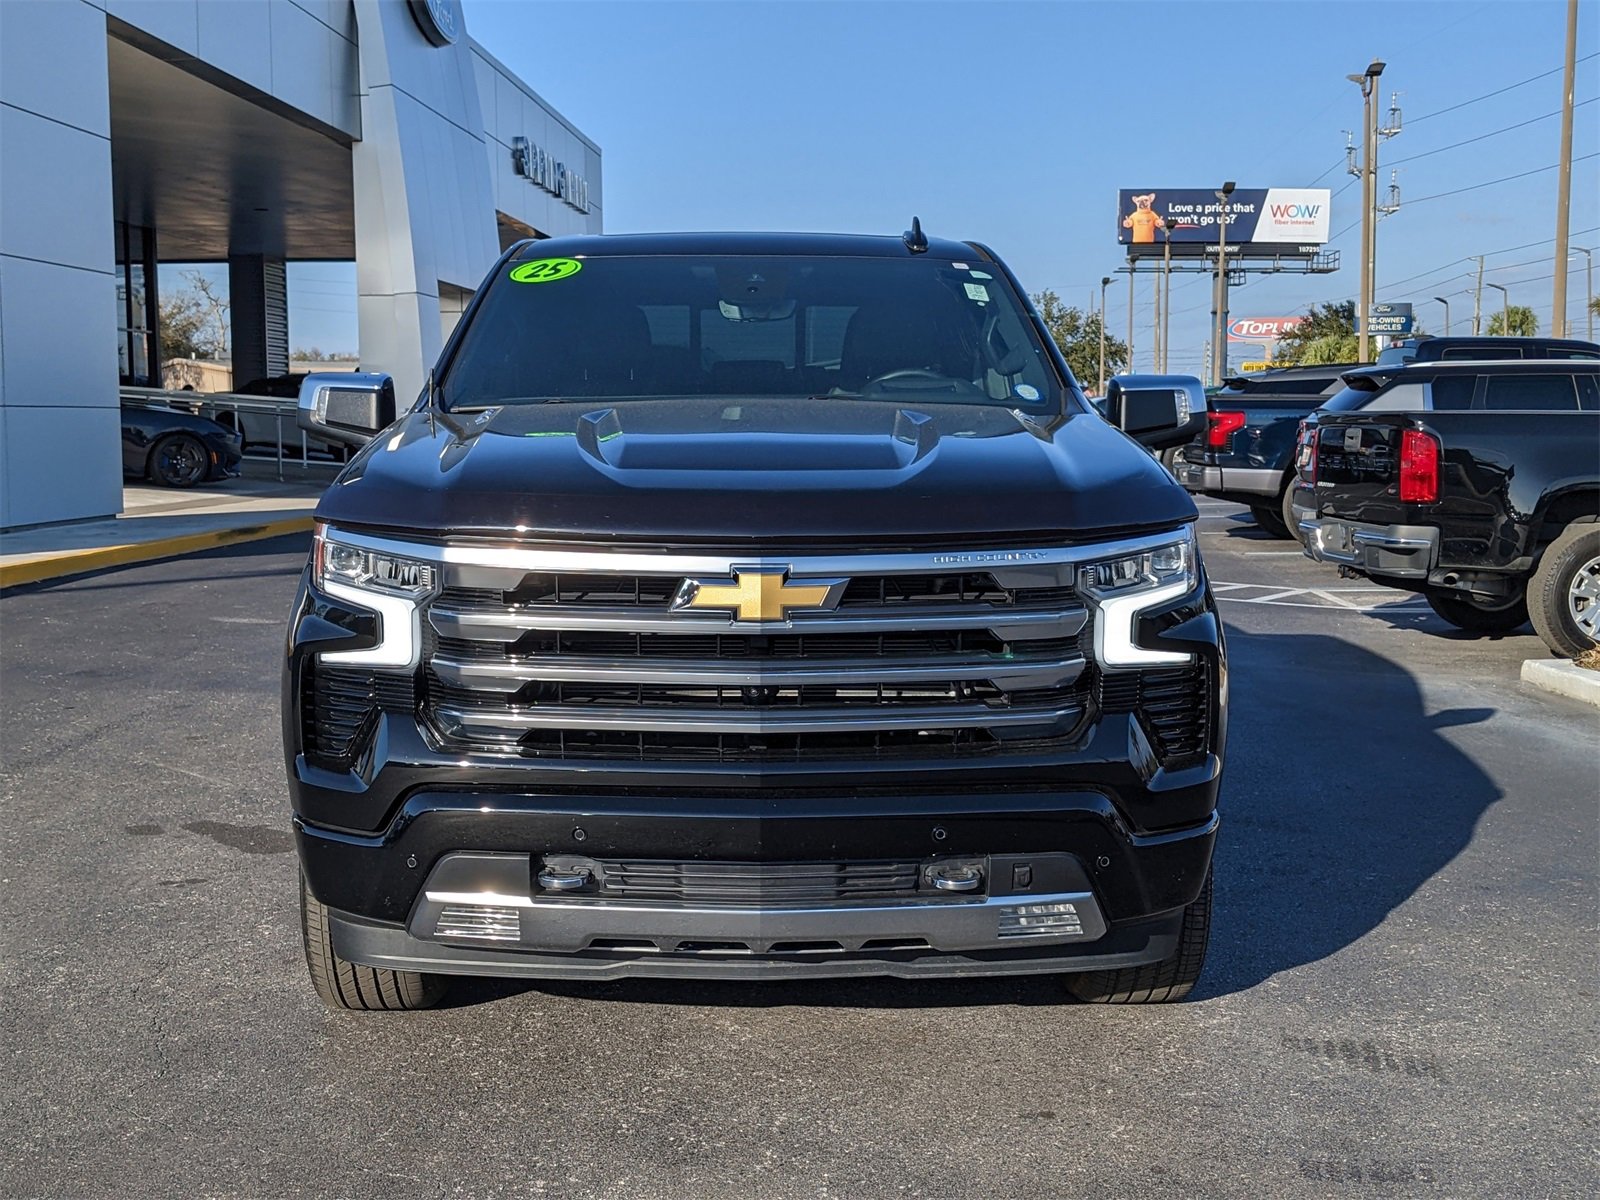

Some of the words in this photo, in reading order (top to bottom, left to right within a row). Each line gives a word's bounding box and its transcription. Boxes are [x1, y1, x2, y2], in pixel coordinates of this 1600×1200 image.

[1168, 203, 1193, 213] Love
[1195, 205, 1202, 213] a
[1205, 202, 1231, 214] price
[1233, 203, 1255, 213] that
[1270, 204, 1320, 218] WOW!
[1168, 214, 1198, 224] on't
[1200, 216, 1215, 226] go
[523, 261, 569, 279] 25
[933, 555, 971, 563] HIGH
[976, 552, 1048, 562] COUNTRY
